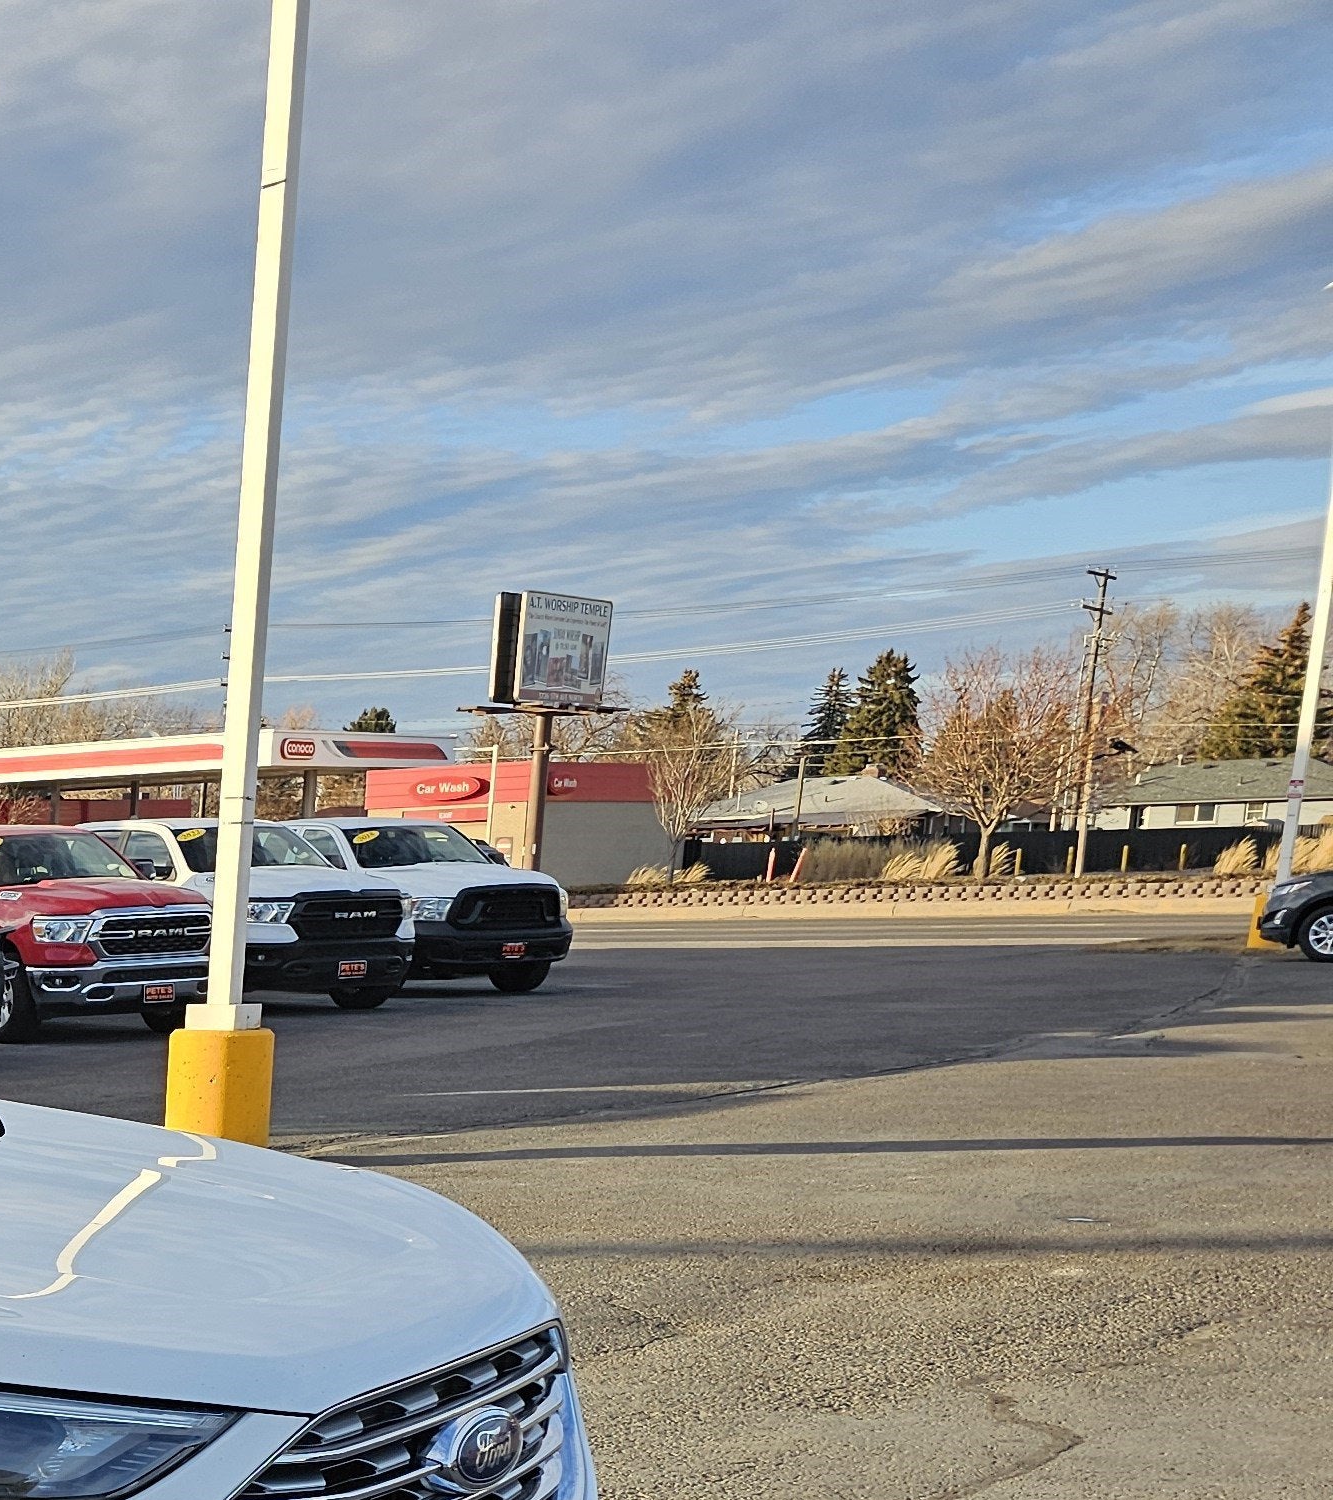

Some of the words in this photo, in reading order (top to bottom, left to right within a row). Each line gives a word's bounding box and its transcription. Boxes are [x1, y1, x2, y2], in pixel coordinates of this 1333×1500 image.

[545, 598, 579, 613] WORSHIP
[581, 603, 608, 617] TEMPLE
[416, 783, 436, 795] Car
[438, 781, 470, 793] Wash
[553, 777, 563, 788] Car
[334, 911, 377, 919] RAM
[137, 927, 184, 938] RAM
[146, 985, 173, 995] PETE'S
[476, 1426, 511, 1474] Ford
